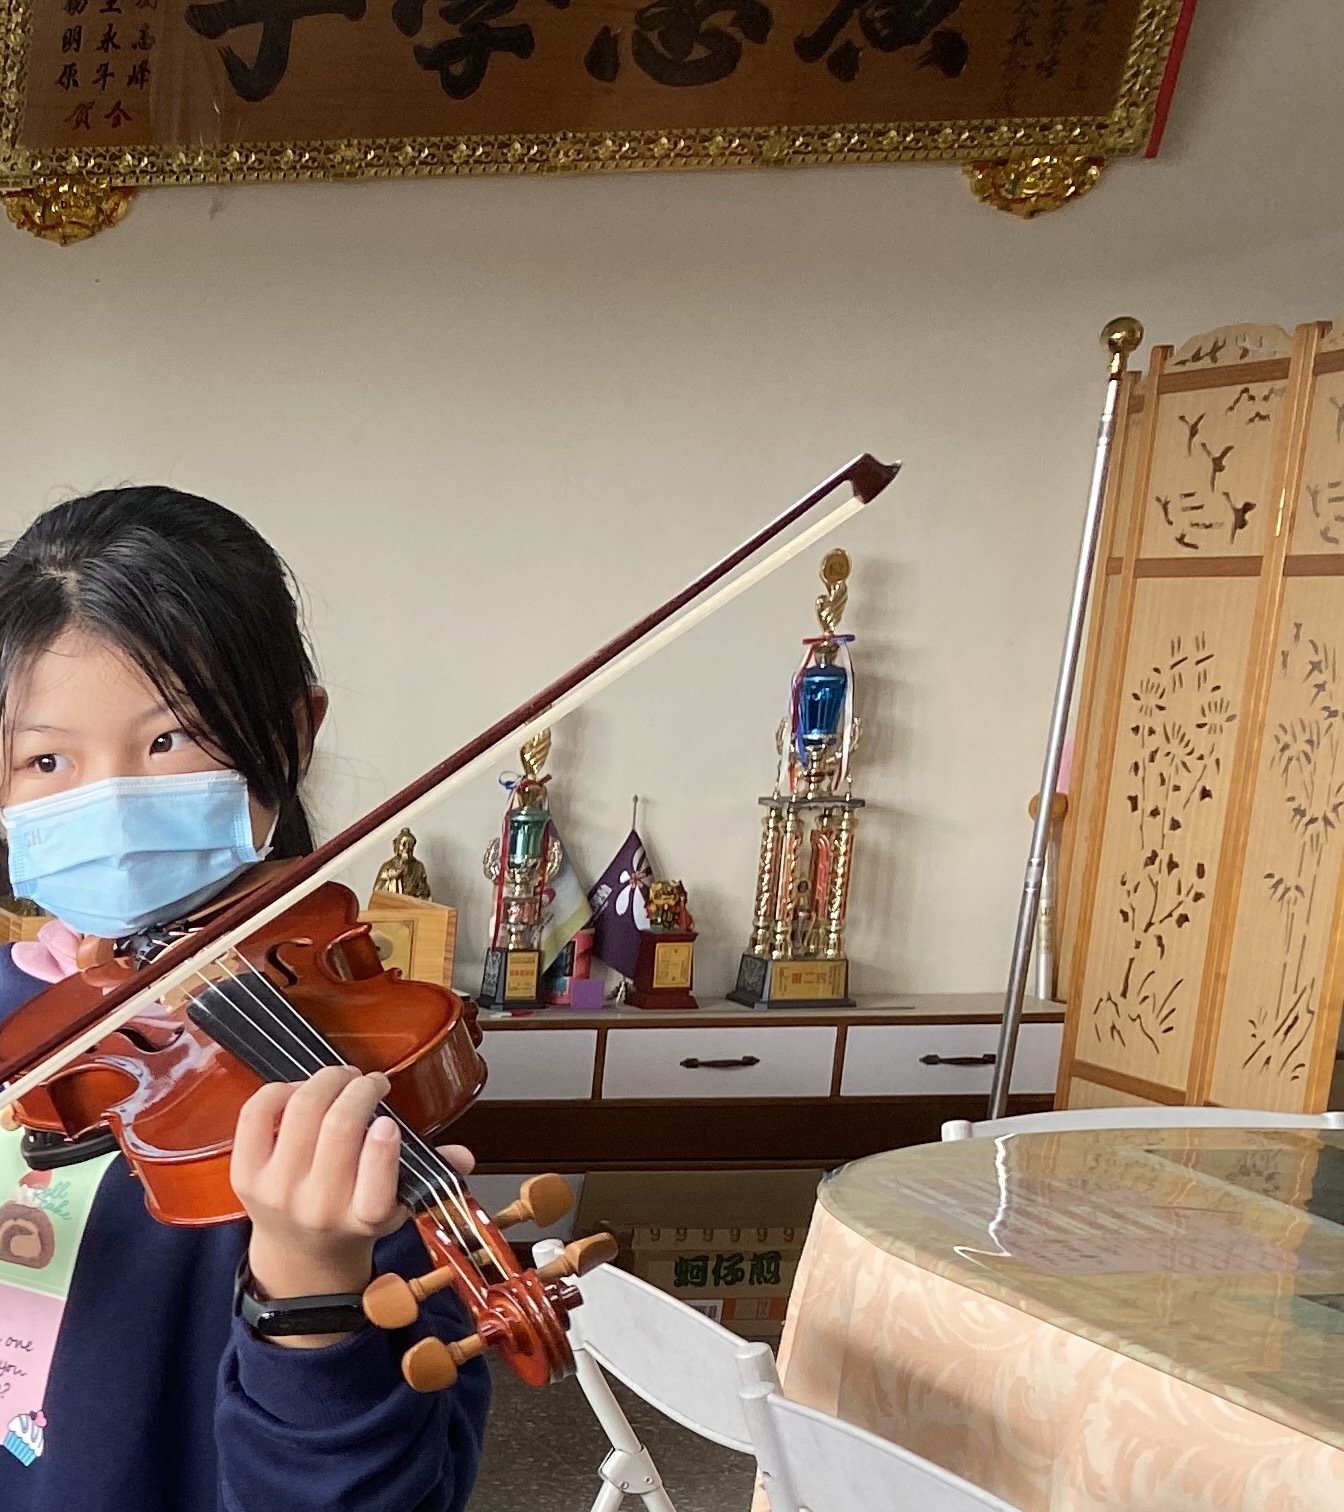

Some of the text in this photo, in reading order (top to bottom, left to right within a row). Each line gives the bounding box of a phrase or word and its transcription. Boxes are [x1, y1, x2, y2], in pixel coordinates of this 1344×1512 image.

[673, 1250, 783, 1287] 蚵仔煎
[5, 1336, 34, 1352] one
